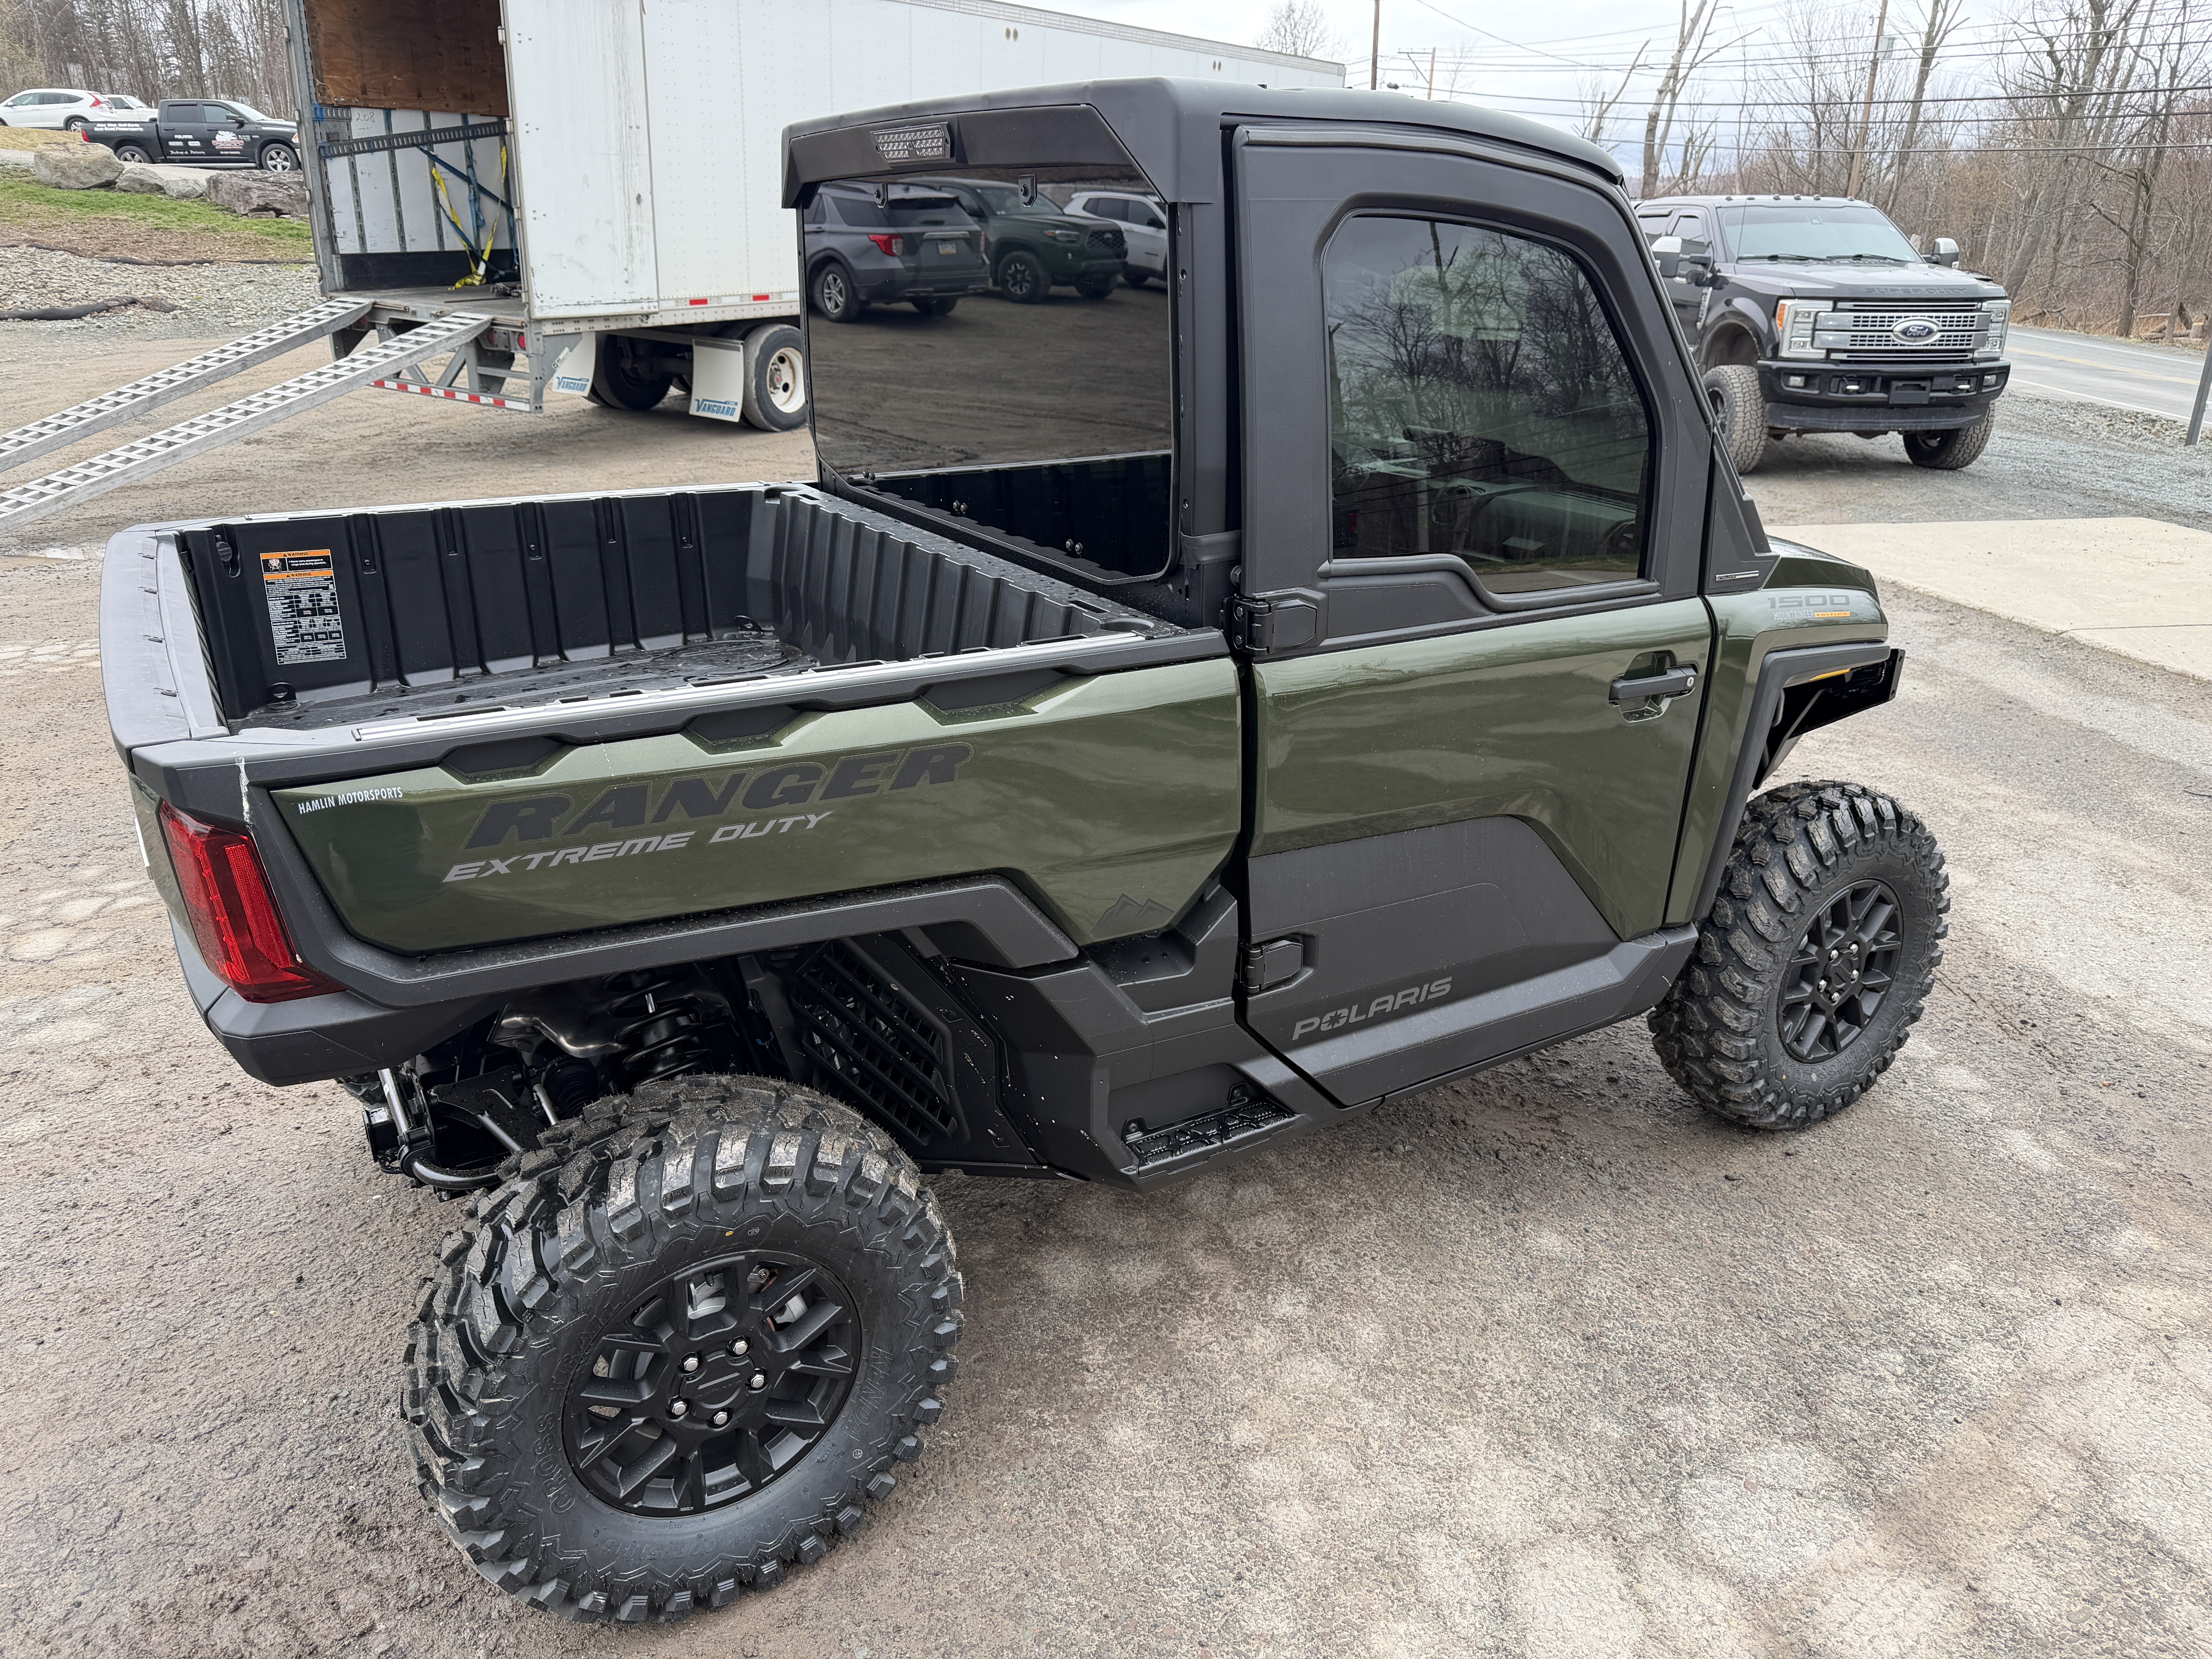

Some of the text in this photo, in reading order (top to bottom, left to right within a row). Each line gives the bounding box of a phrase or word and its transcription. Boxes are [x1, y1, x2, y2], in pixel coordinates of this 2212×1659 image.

[356, 112, 374, 122] 208
[1906, 326, 1929, 336] Ford
[556, 377, 589, 392] VANGUARD
[695, 399, 738, 416] VANGUARD
[1767, 595, 1850, 609] 1500
[1773, 610, 1814, 620] MOUNTAINEER
[298, 787, 403, 814] HAMLIN MOTORSPORTS
[461, 744, 973, 850] RANGER
[441, 810, 835, 883] EXTREME DUTY
[1292, 976, 1453, 1041] POLARIS
[842, 1346, 893, 1441] KENDA
[533, 1412, 576, 1514] CROSS
